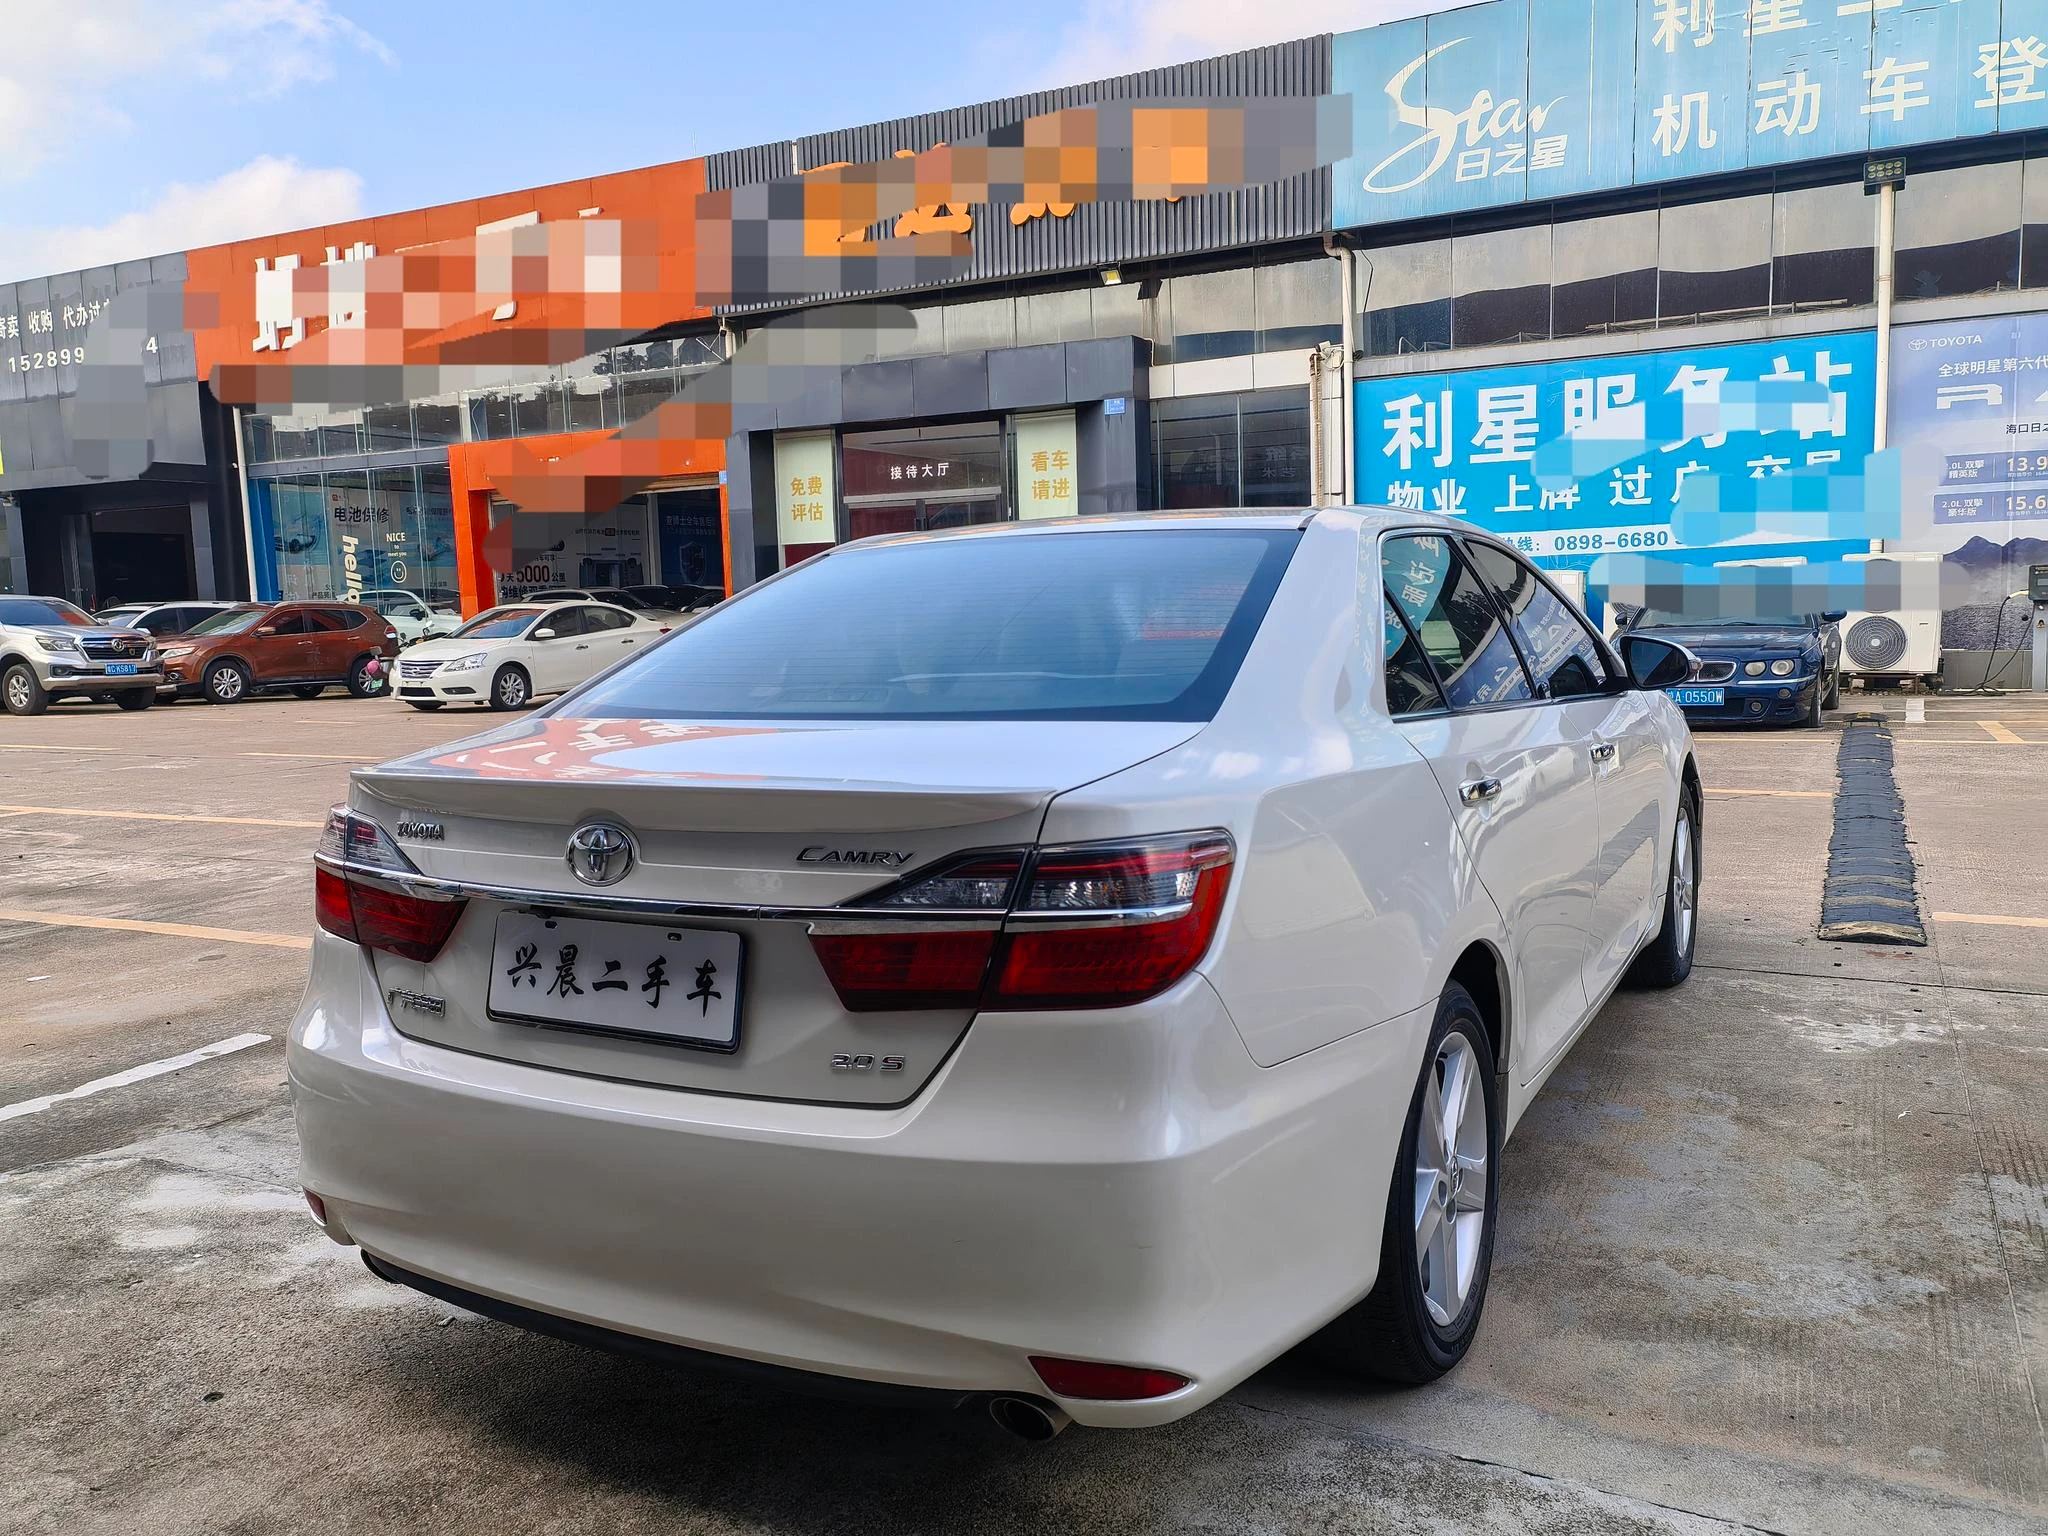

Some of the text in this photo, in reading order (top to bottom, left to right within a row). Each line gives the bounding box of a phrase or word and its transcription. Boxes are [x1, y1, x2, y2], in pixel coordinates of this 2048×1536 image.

[1652, 35, 2048, 157] 机动车登
[1363, 36, 1569, 193] Star
[1455, 134, 1568, 182] 日之星
[28, 310, 53, 334] 收购
[1930, 334, 1983, 348] TOYOTA
[890, 462, 950, 480] 接待大厅
[1031, 450, 1071, 473] 看车
[790, 476, 823, 497] 免费
[1031, 478, 1071, 500] 请进
[1386, 478, 1467, 515] 物业
[334, 506, 390, 524] 电池保修
[790, 503, 824, 522] 评估
[386, 532, 406, 542] NICE
[342, 534, 363, 604] hello
[397, 821, 445, 840] TOYOTA
[796, 846, 915, 868] CAMRY
[507, 942, 722, 1018] 兴晨二手车
[880, 1054, 905, 1072] S
